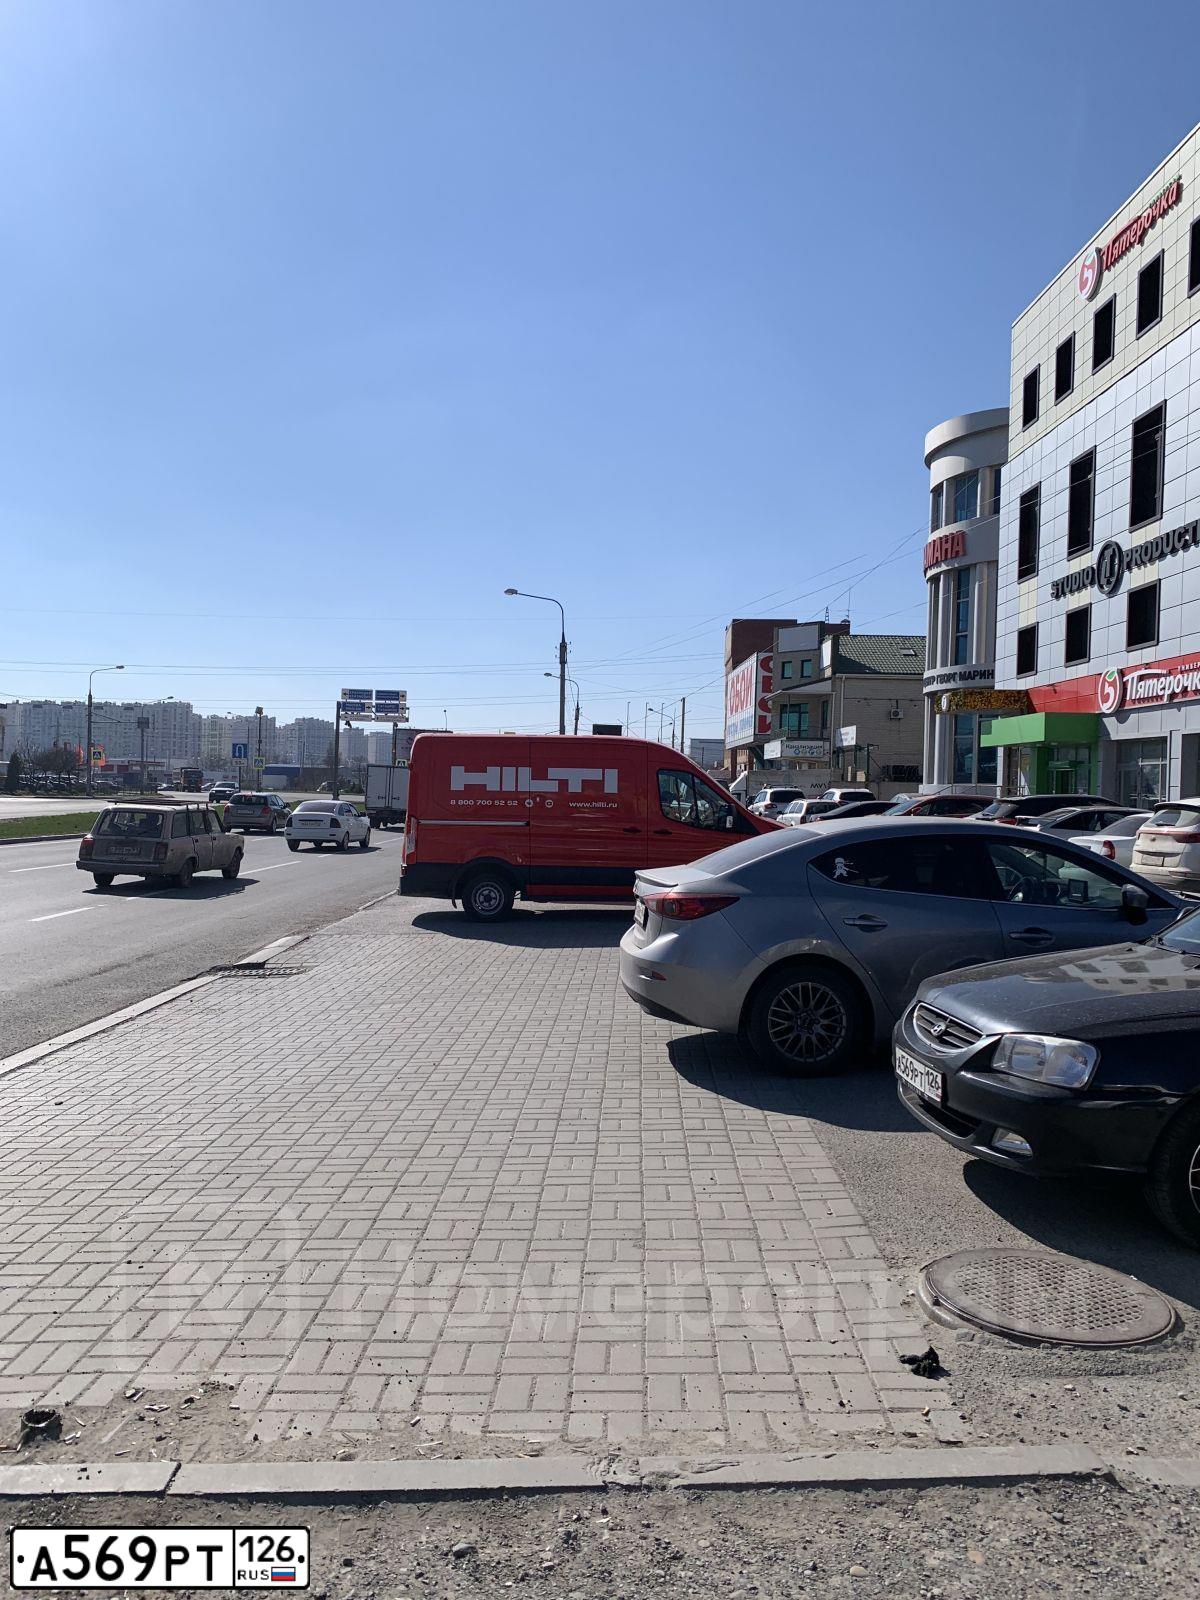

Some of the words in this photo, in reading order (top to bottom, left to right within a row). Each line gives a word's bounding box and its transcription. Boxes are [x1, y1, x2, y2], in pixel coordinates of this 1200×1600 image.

[1101, 181, 1181, 271] Пятерочка
[1051, 566, 1094, 598] STUDIO
[959, 669, 995, 681] МАРИН
[450, 765, 618, 793] HILTI
[569, 801, 618, 809] www.hilti.ru
[925, 1070, 940, 1090] 126
